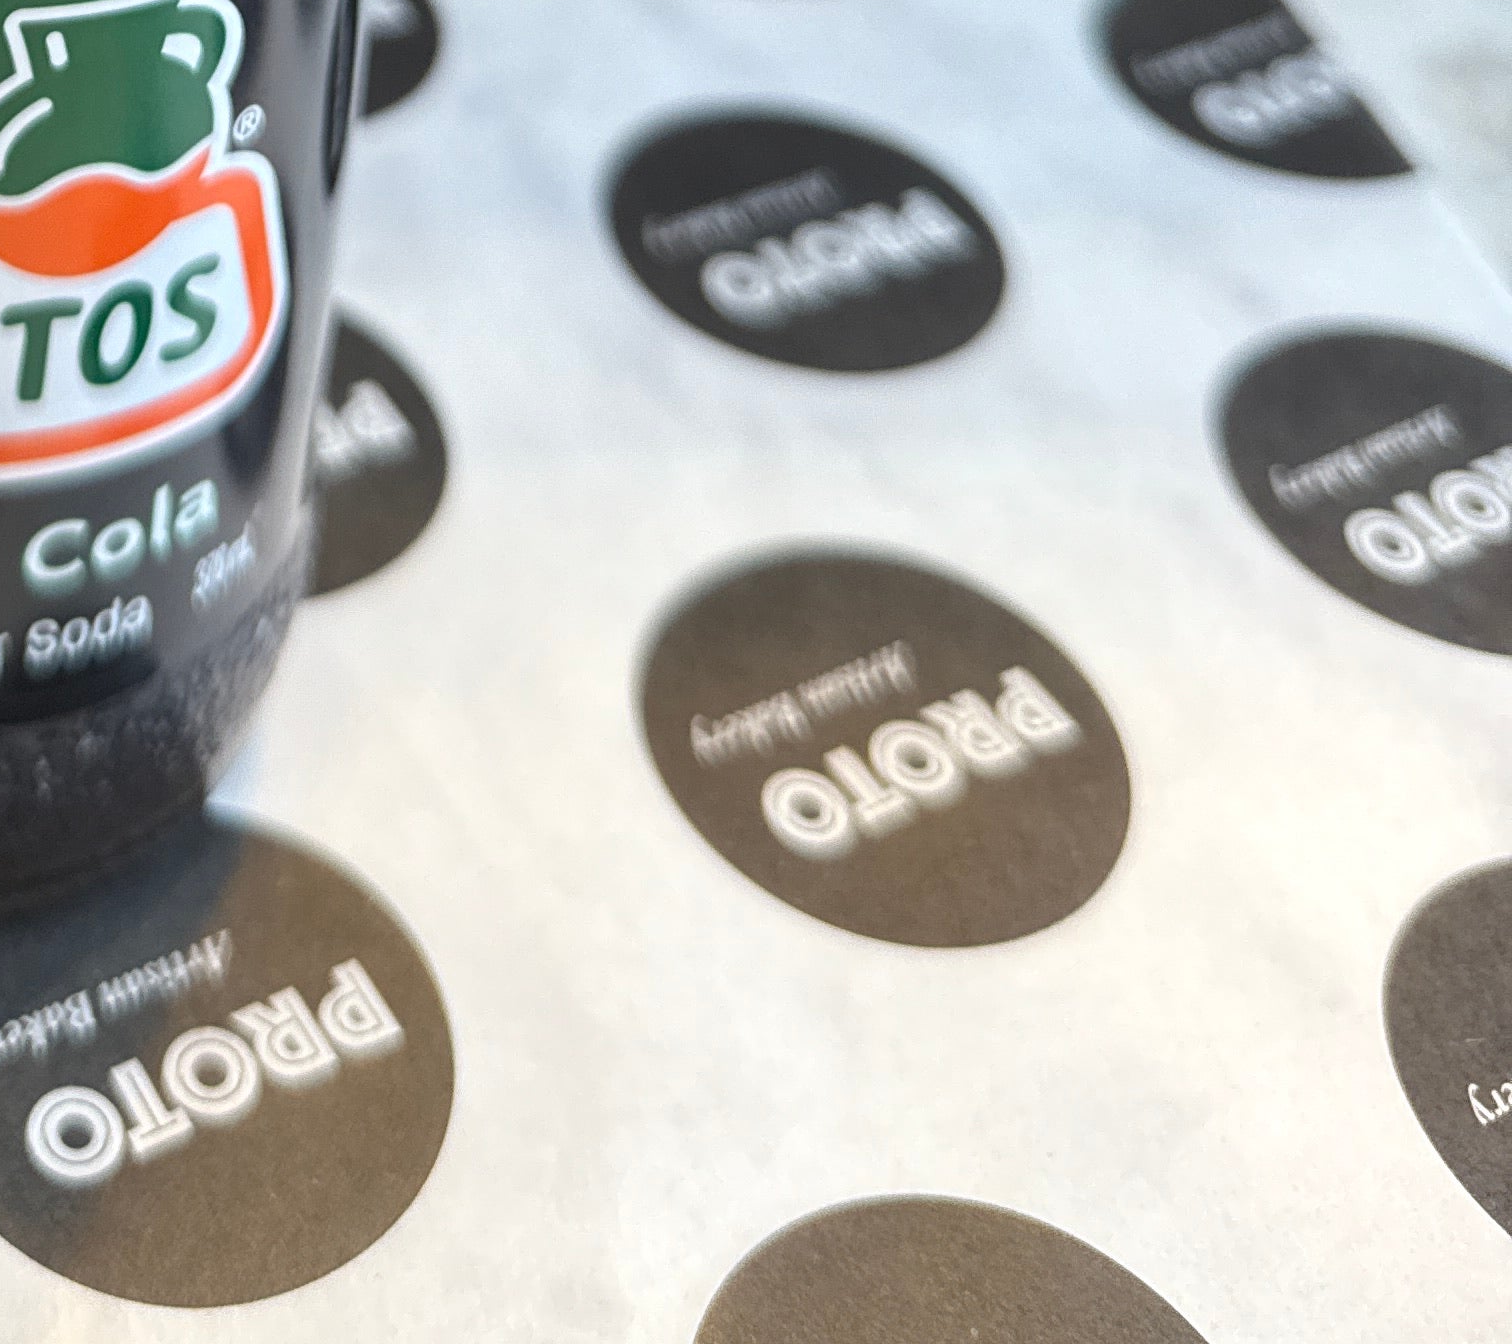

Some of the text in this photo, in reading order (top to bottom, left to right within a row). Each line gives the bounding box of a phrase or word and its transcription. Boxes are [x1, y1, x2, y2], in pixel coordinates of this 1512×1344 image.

[22, 478, 220, 590] Cola
[26, 594, 155, 662] Soda
[760, 665, 1082, 860] PROTO
[96, 926, 234, 1018] Artisan
[23, 957, 404, 1187] PROTO
